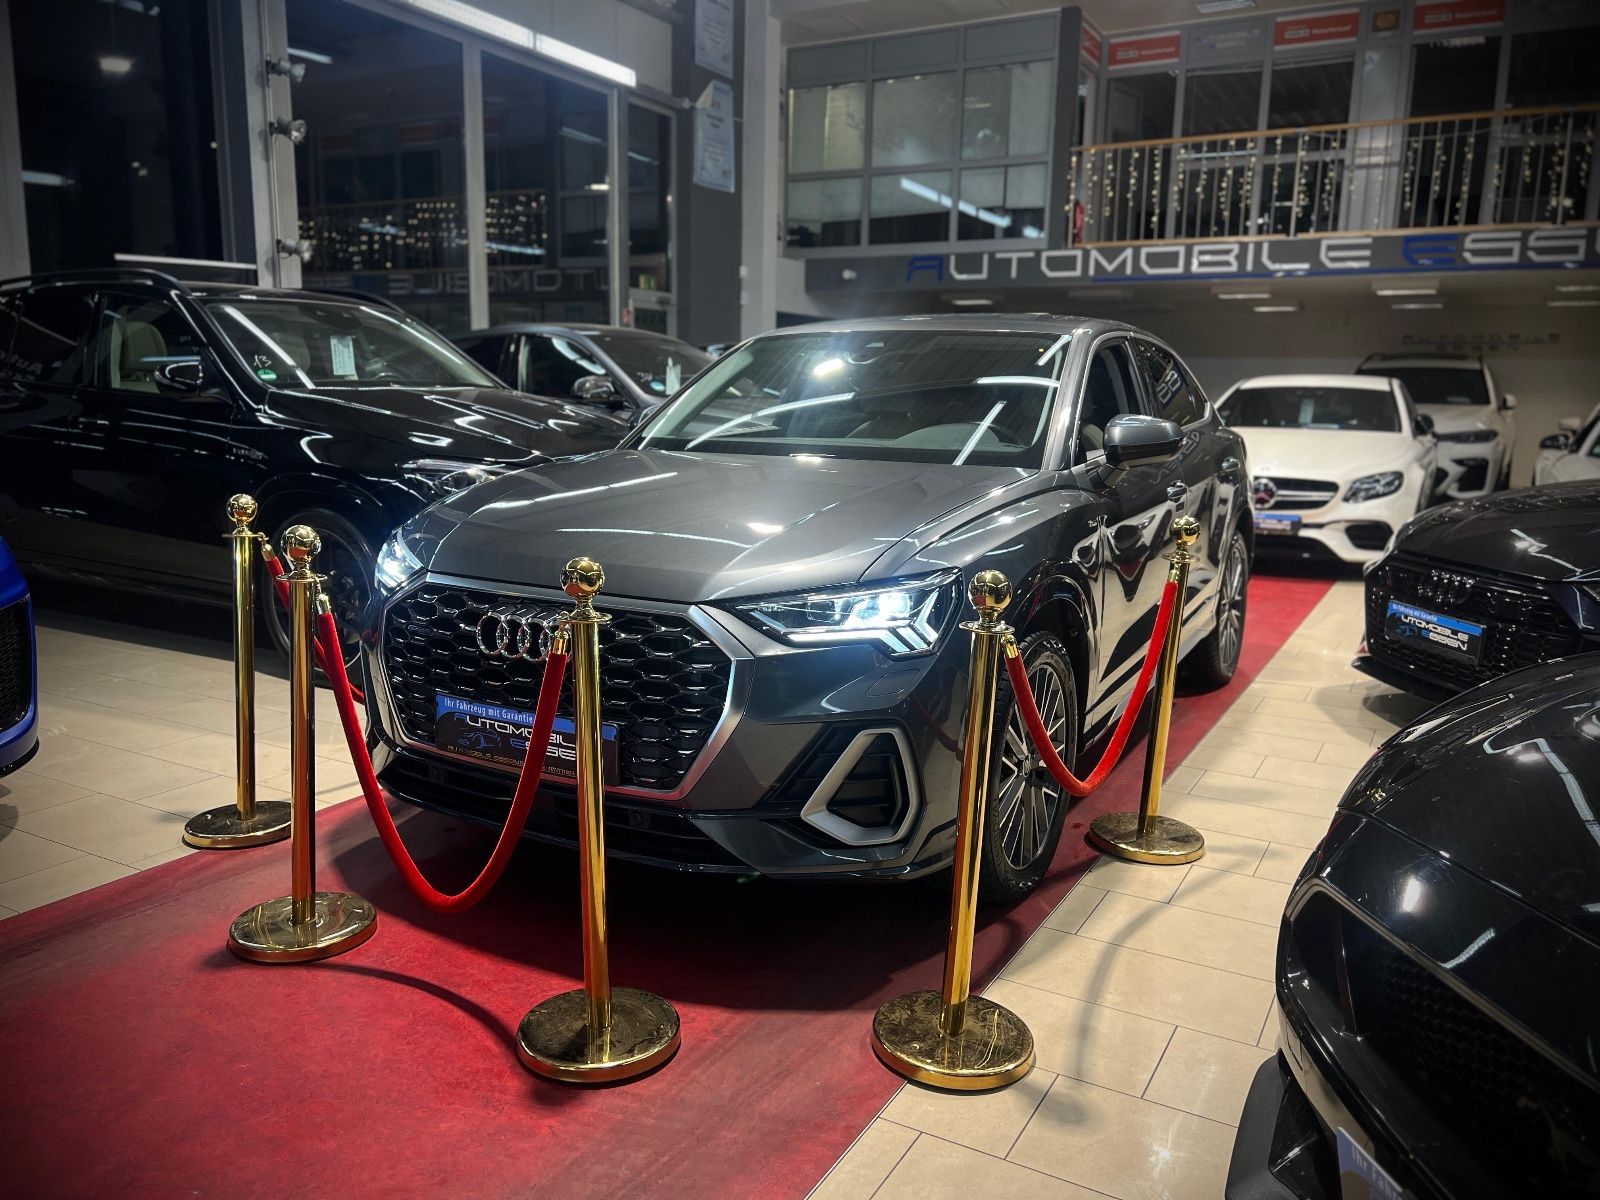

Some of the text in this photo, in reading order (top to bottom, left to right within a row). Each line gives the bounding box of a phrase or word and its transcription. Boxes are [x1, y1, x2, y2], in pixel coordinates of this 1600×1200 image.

[907, 229, 1600, 282] AUTOMOBILE ESS
[444, 697, 455, 708] Ihr
[456, 700, 486, 717] Fahrzeug
[488, 708, 500, 718] mit
